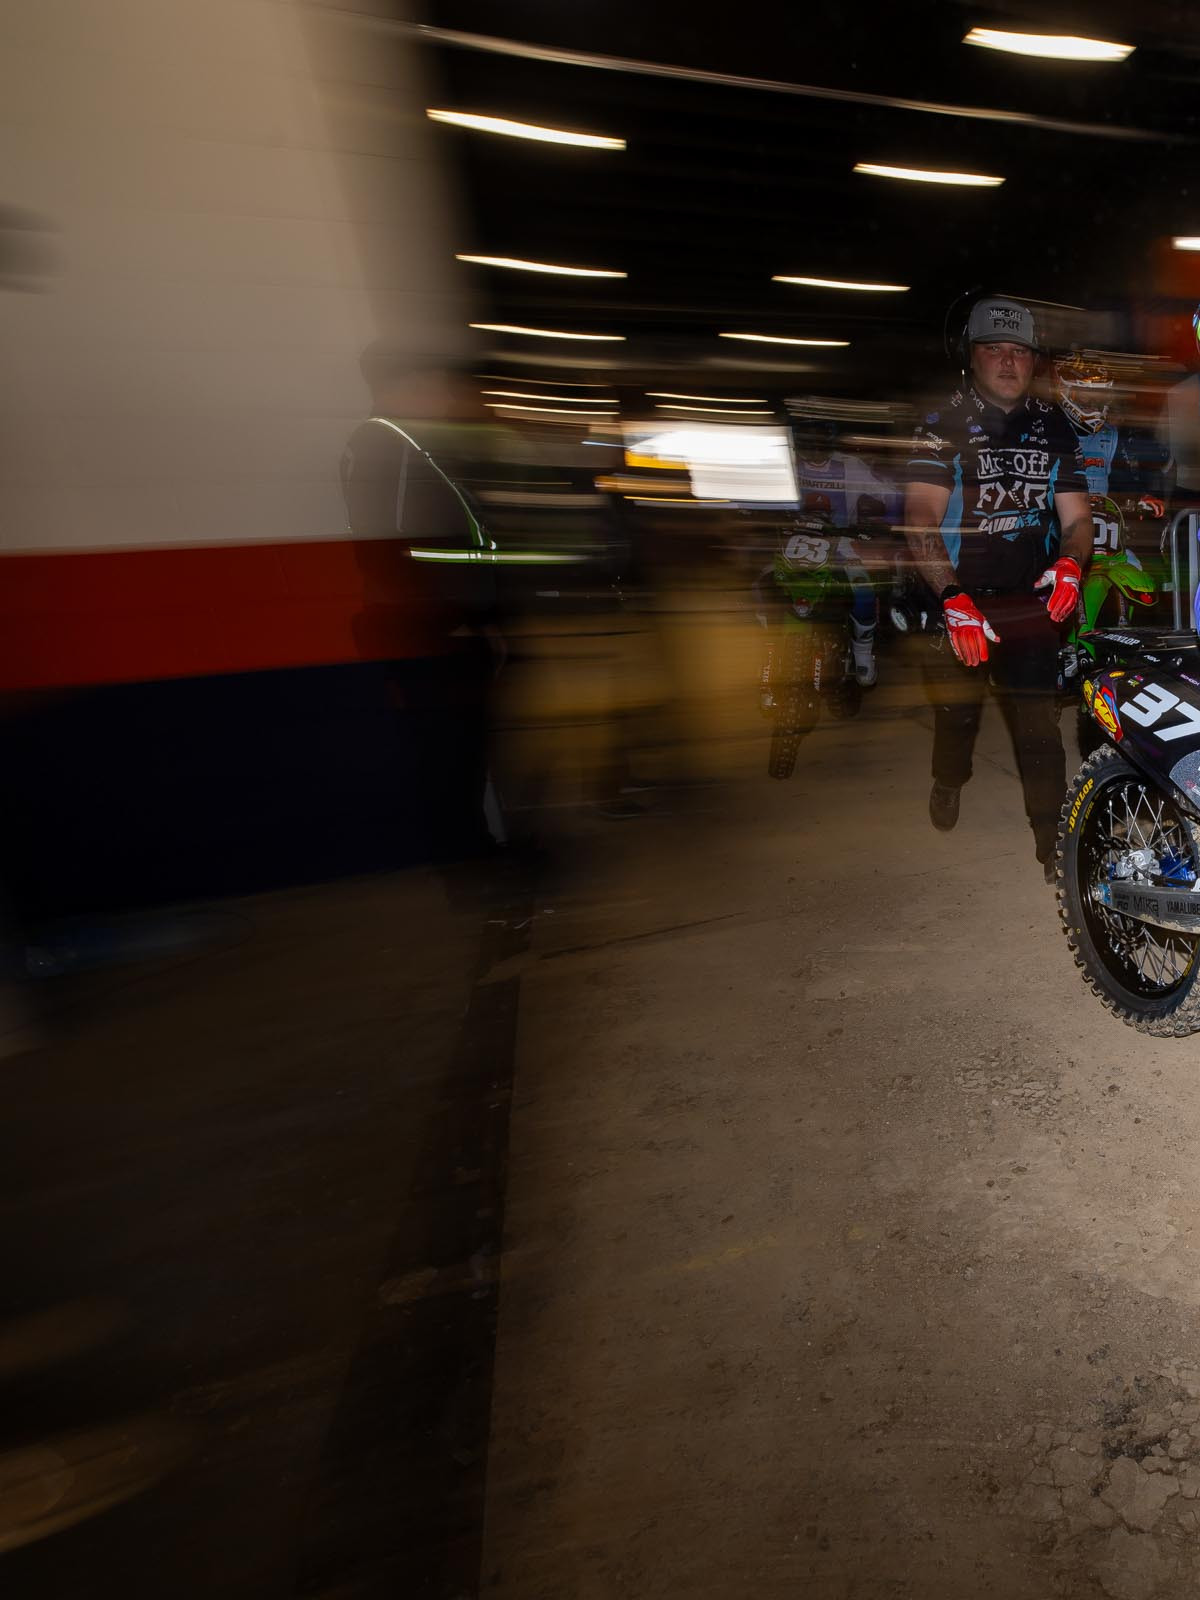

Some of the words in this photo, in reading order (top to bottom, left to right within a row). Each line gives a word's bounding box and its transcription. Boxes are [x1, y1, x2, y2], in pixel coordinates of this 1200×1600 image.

[994, 319, 1020, 331] FXR
[785, 534, 830, 563] 63
[1103, 633, 1141, 646] DUNLOP
[1070, 778, 1094, 829] DUNLOP
